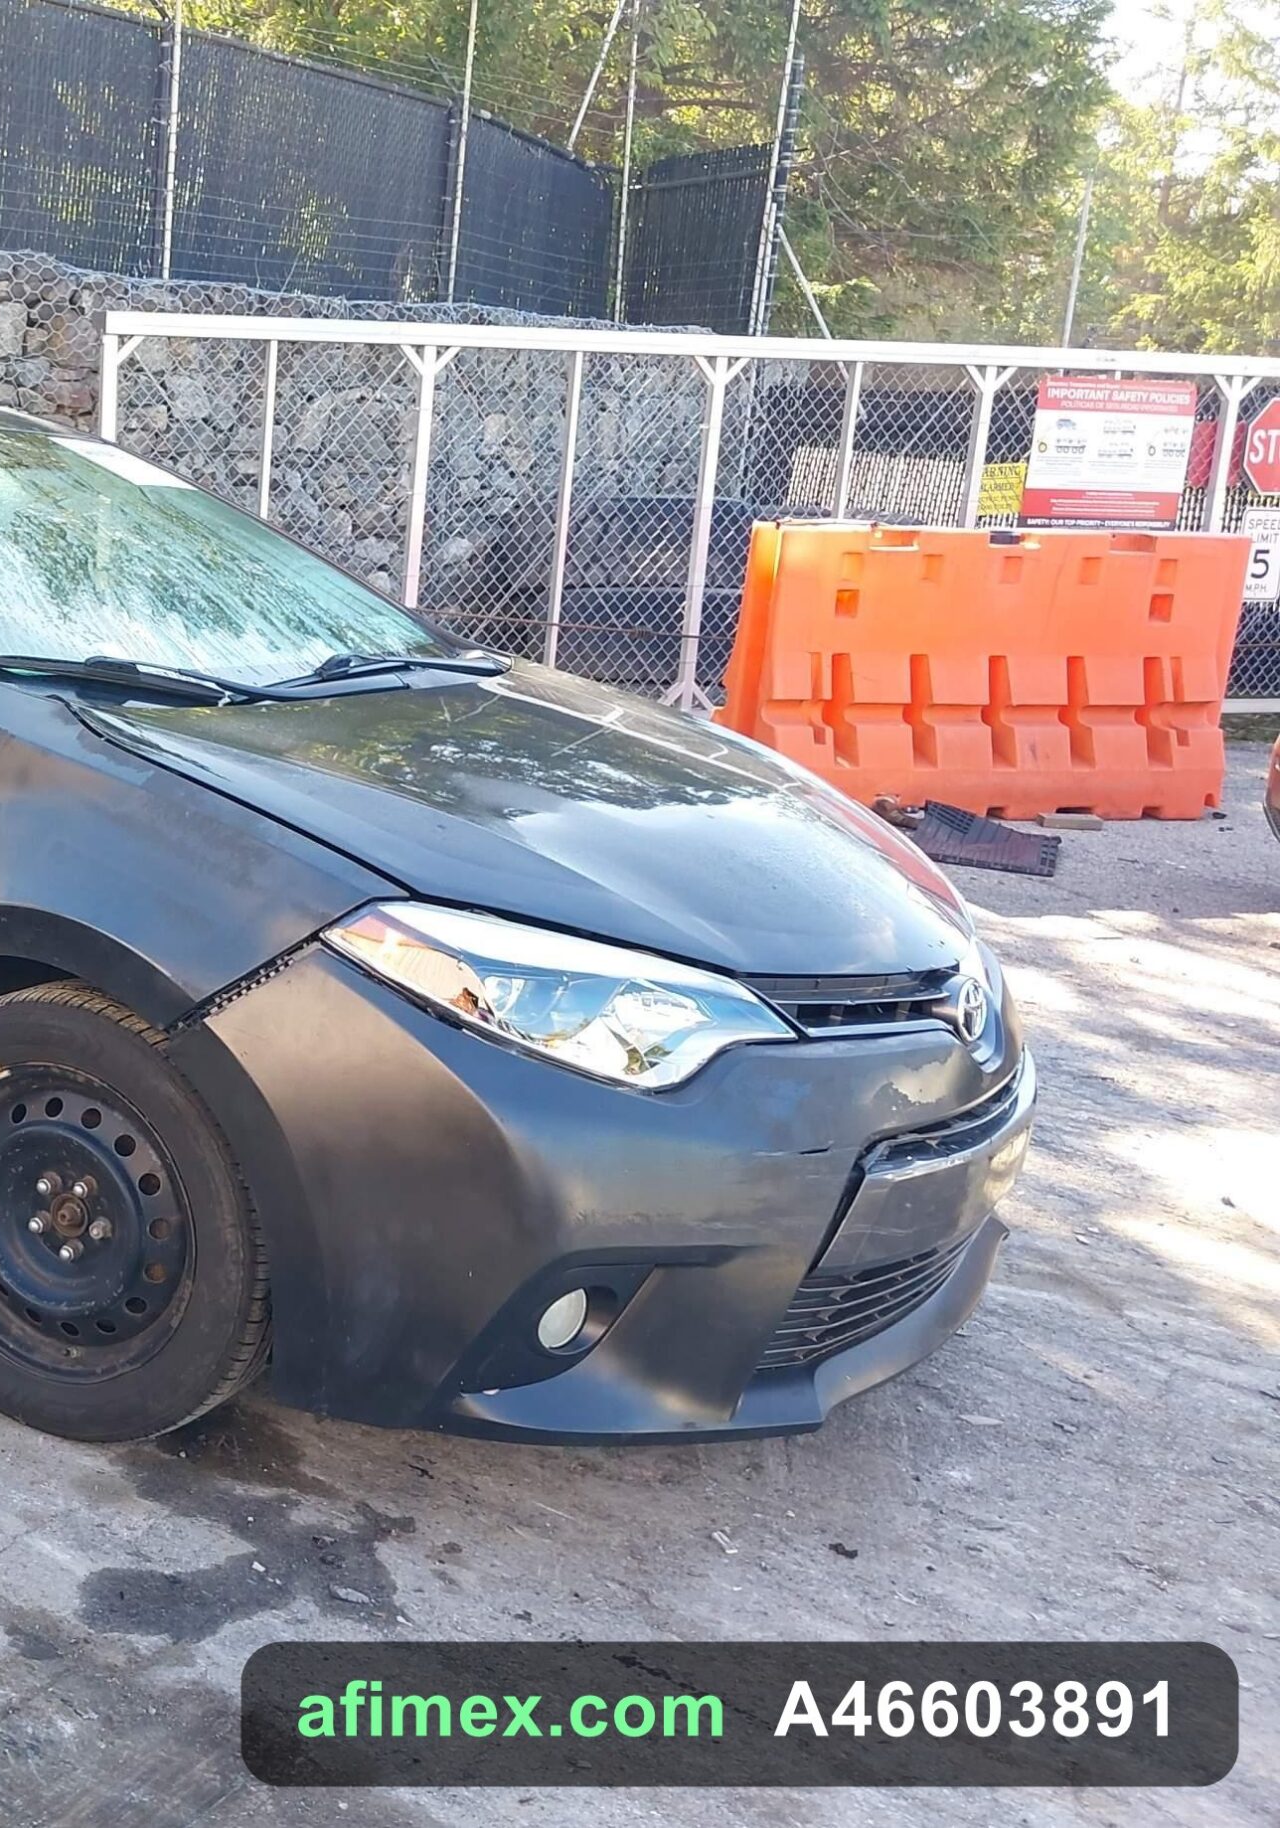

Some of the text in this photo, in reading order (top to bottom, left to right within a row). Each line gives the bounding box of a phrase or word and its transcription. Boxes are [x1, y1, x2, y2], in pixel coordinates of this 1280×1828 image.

[1047, 387, 1110, 401] IMPORTANT
[1111, 390, 1149, 403] SAFETY
[1150, 392, 1191, 405] POLICIES
[1249, 429, 1280, 464] ST
[981, 465, 1022, 477] ARNING
[1248, 518, 1280, 530] SPEE
[1250, 549, 1271, 579] 5
